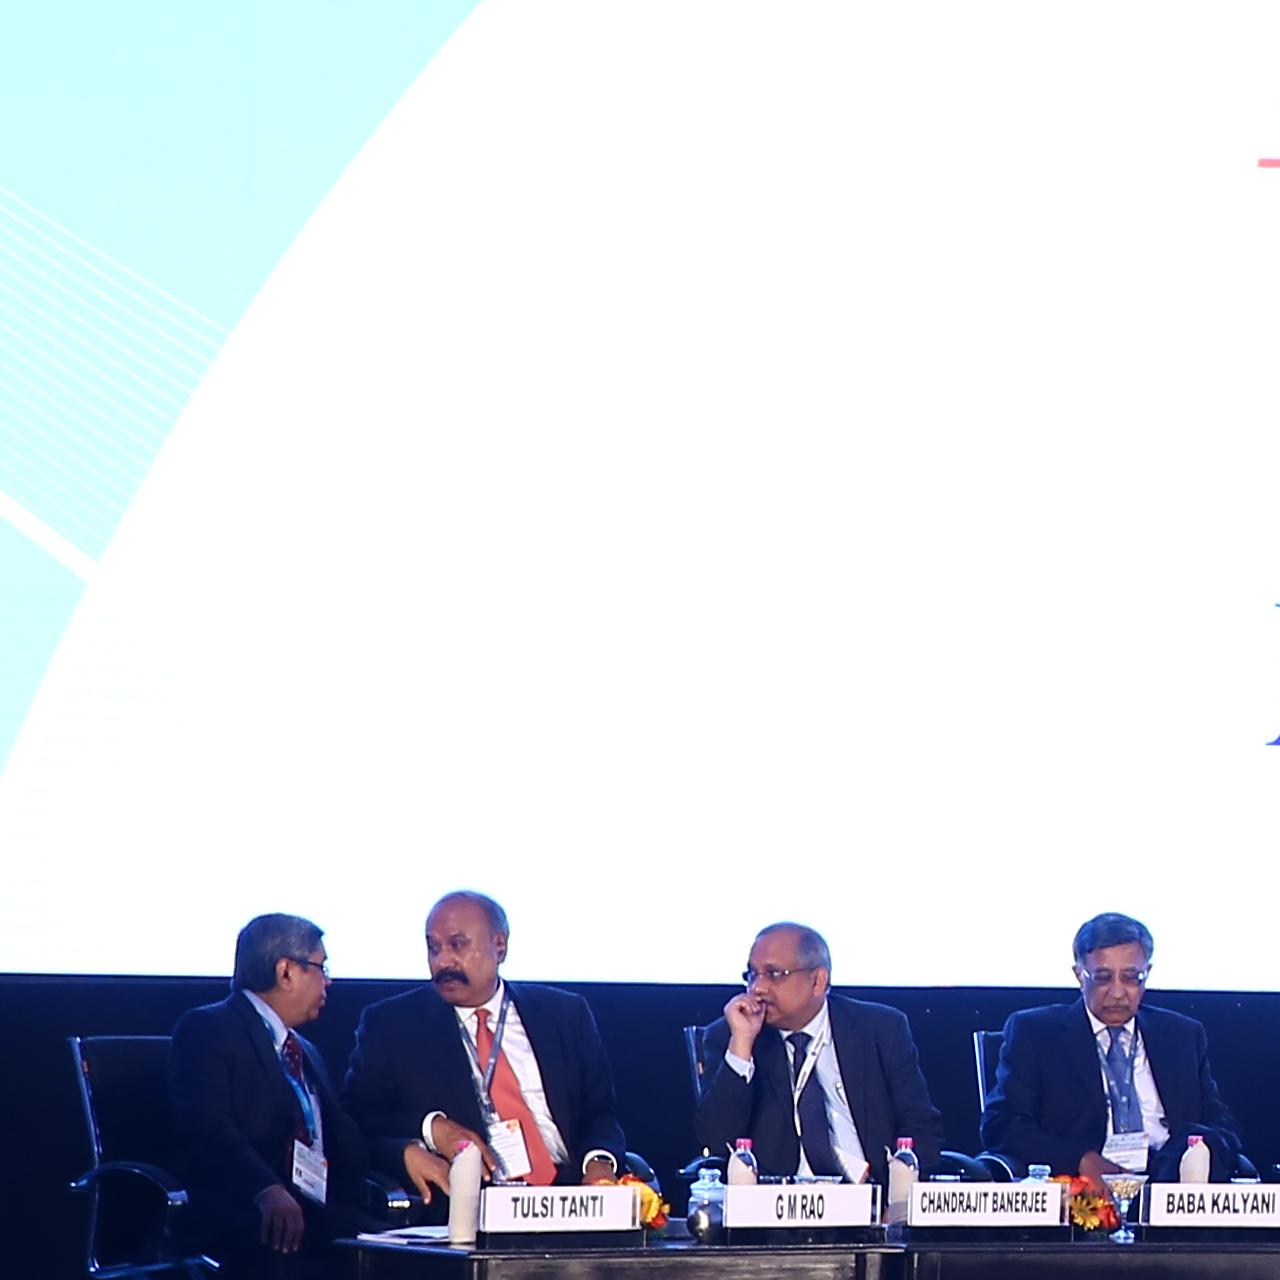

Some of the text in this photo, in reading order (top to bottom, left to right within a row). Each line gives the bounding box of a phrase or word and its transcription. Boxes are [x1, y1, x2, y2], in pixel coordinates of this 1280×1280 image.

[510, 1195, 604, 1219] TULSI TANTI
[775, 1194, 825, 1221] G M RAO
[920, 1191, 1048, 1214] CHANDRAJIT BANERJEE
[1165, 1192, 1276, 1215] BABA KALYANI
